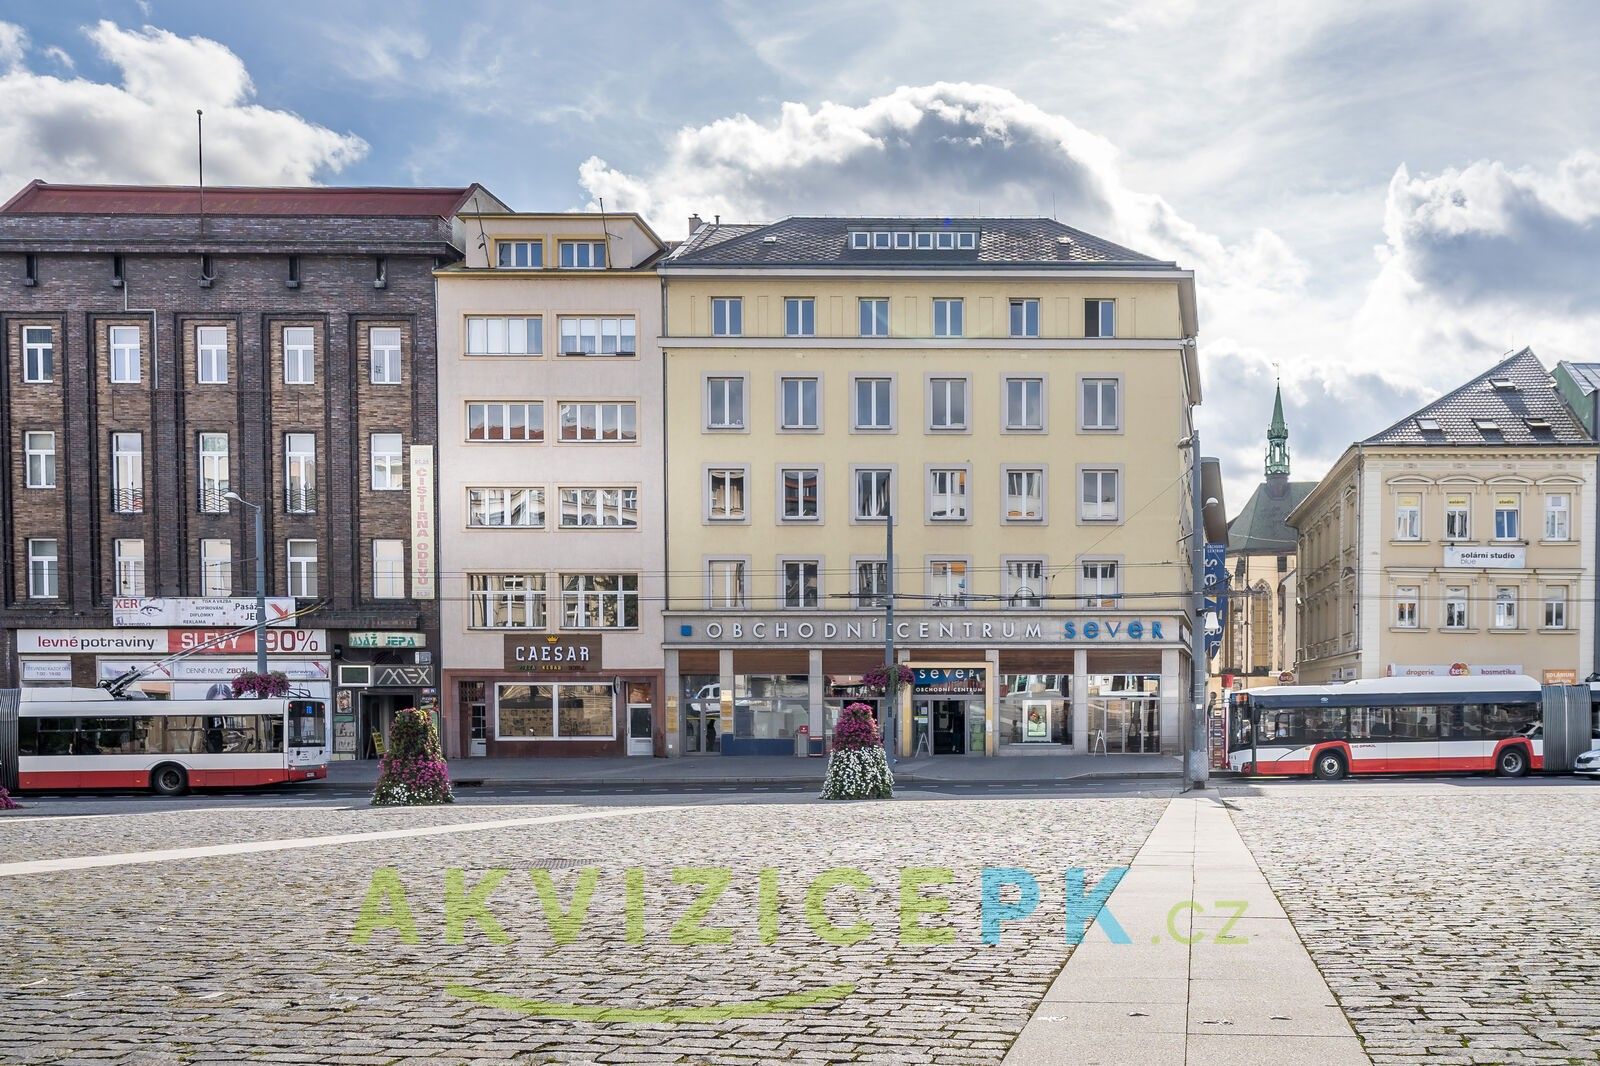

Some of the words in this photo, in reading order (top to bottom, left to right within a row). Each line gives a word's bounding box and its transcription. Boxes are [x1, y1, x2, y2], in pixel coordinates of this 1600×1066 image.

[1461, 551, 1489, 560] solární
[1490, 551, 1516, 560] studio
[706, 618, 879, 639] OBCHODNÍ
[896, 622, 1042, 639] CENTRUM
[38, 635, 79, 648] levné
[80, 635, 156, 650] potraviny
[181, 631, 240, 649] SLEVY
[385, 636, 416, 646] JEPA
[515, 646, 589, 661] CAESAR
[1406, 668, 1435, 677] drogerie
[1450, 667, 1469, 676] teta
[1481, 668, 1517, 676] kosmetika
